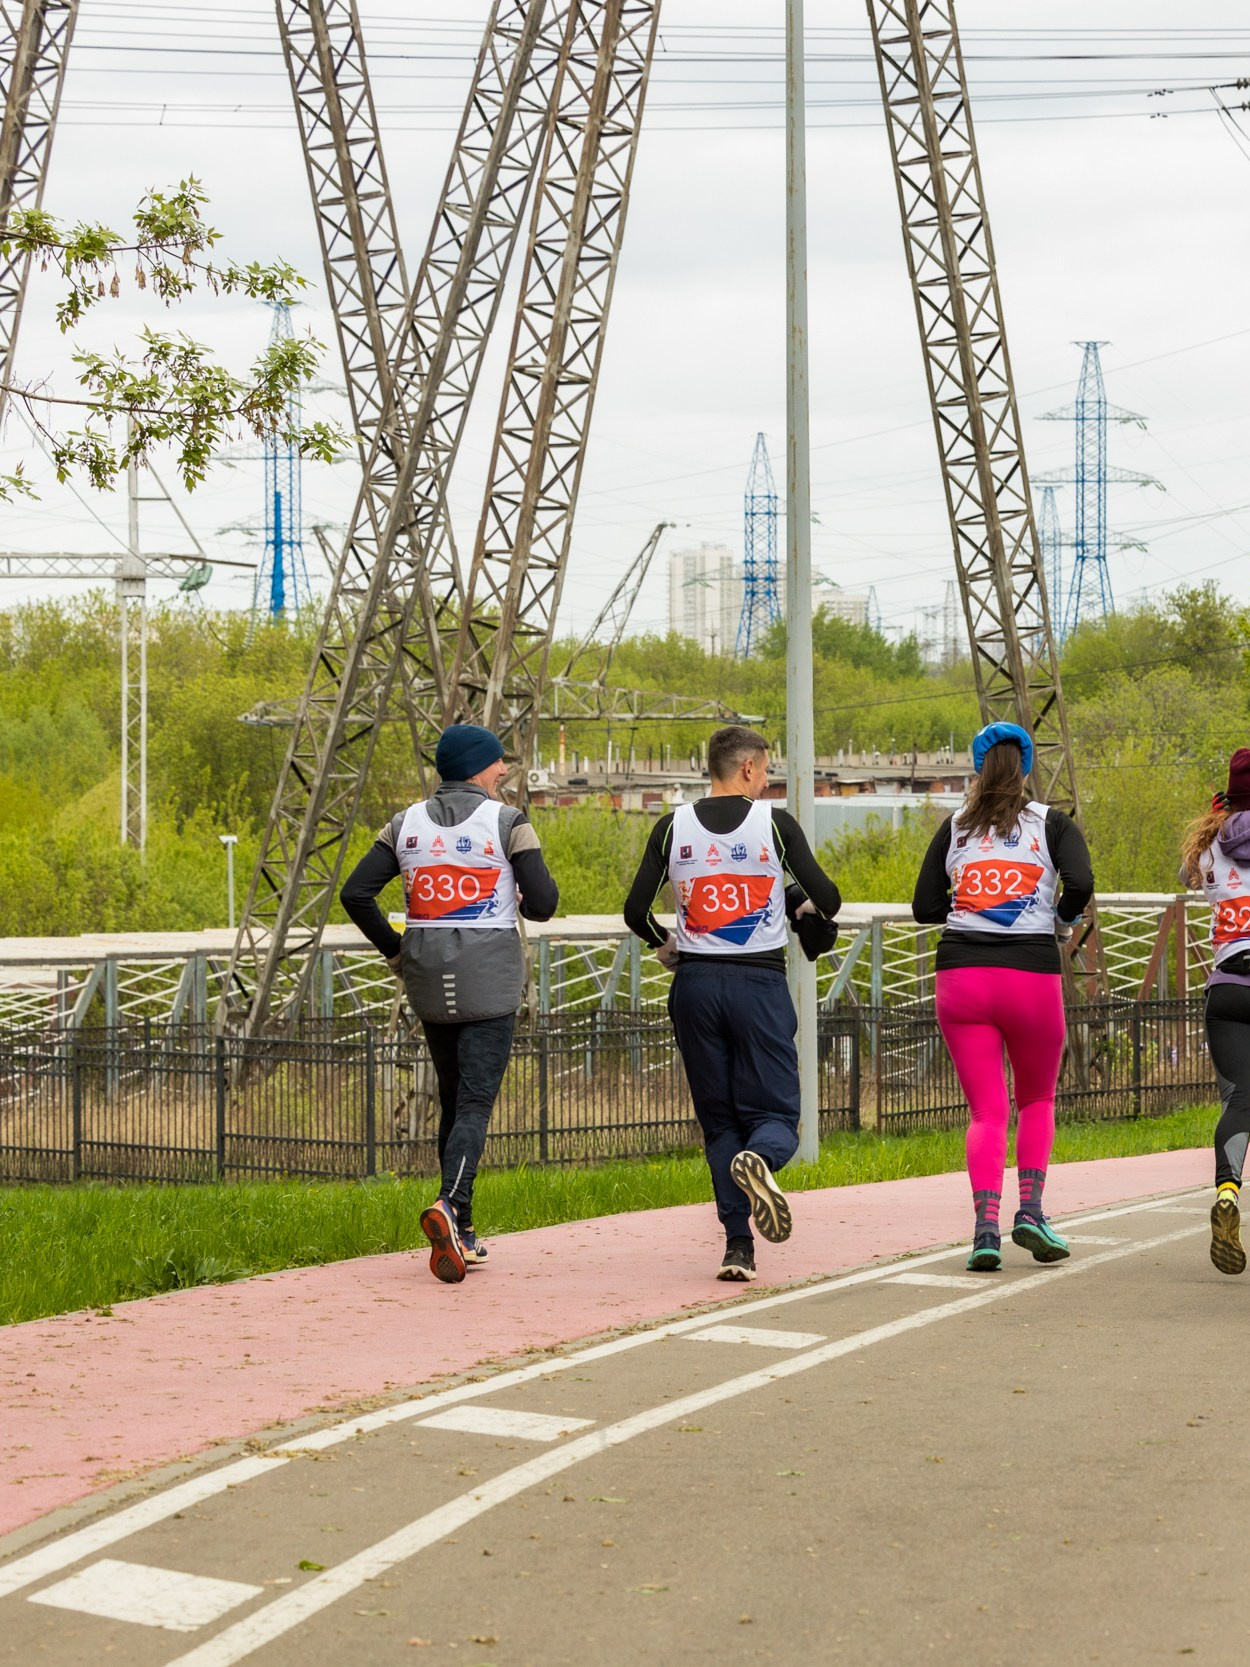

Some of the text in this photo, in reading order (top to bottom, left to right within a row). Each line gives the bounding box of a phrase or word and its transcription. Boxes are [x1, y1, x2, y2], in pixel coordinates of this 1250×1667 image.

[417, 874, 480, 902] 330
[966, 868, 1023, 895] 332
[702, 883, 751, 913] 331
